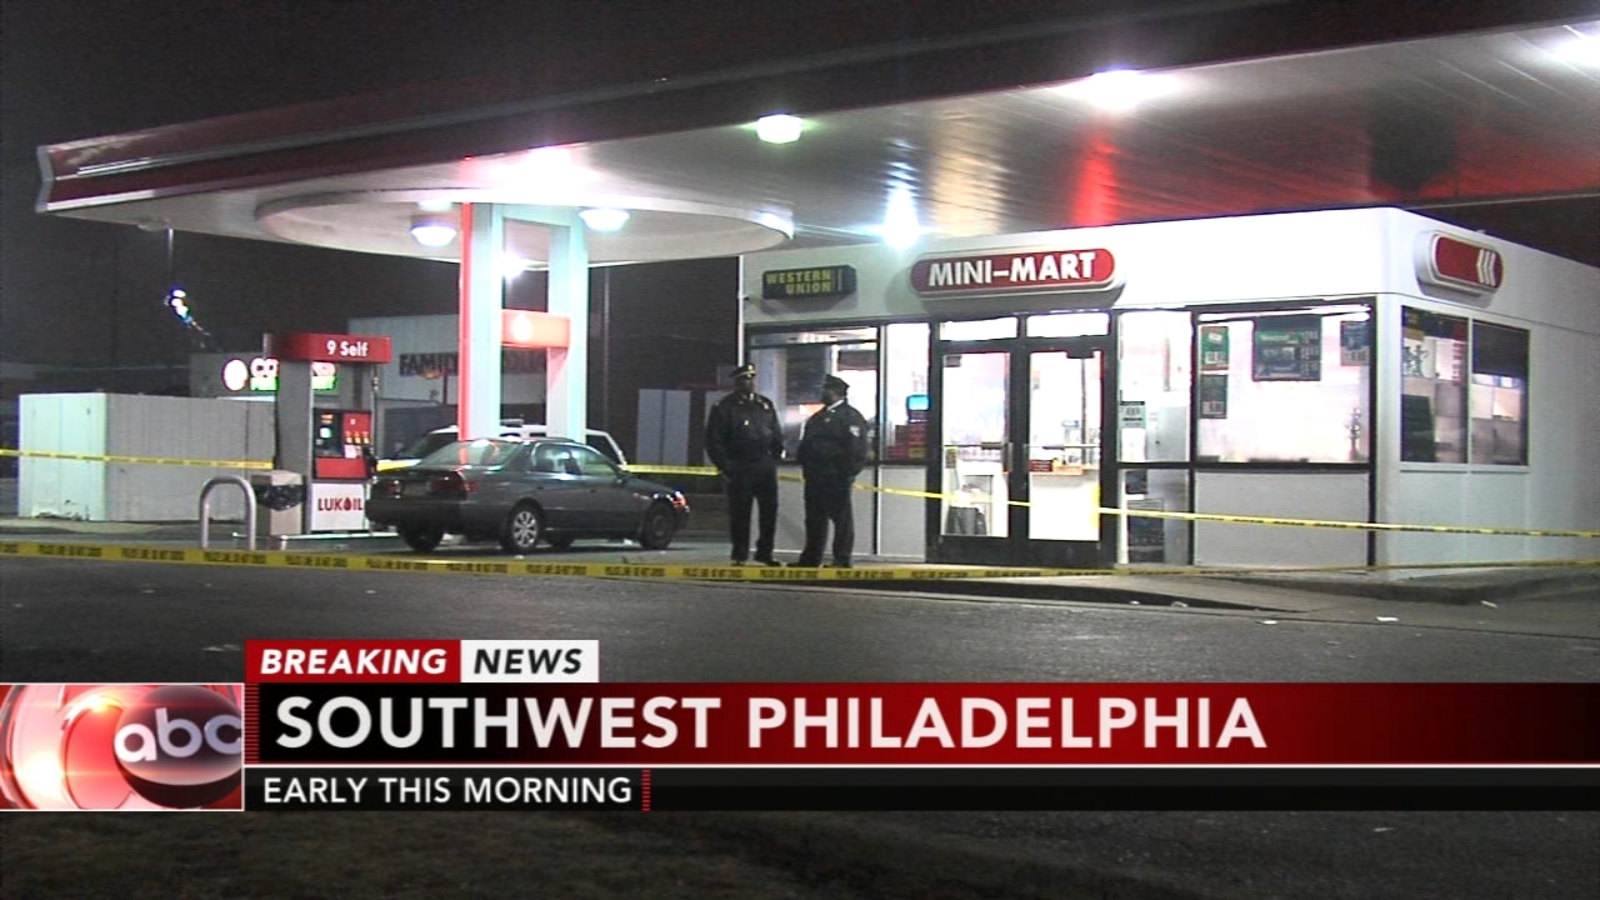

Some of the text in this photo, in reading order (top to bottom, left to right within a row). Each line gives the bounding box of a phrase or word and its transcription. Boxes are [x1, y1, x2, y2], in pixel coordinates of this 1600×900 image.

[766, 269, 831, 284] WESTERN
[928, 252, 1095, 288] MINI-MART
[786, 281, 831, 295] UNION
[326, 340, 369, 357] 9 Self
[318, 497, 364, 511] LUKOIL
